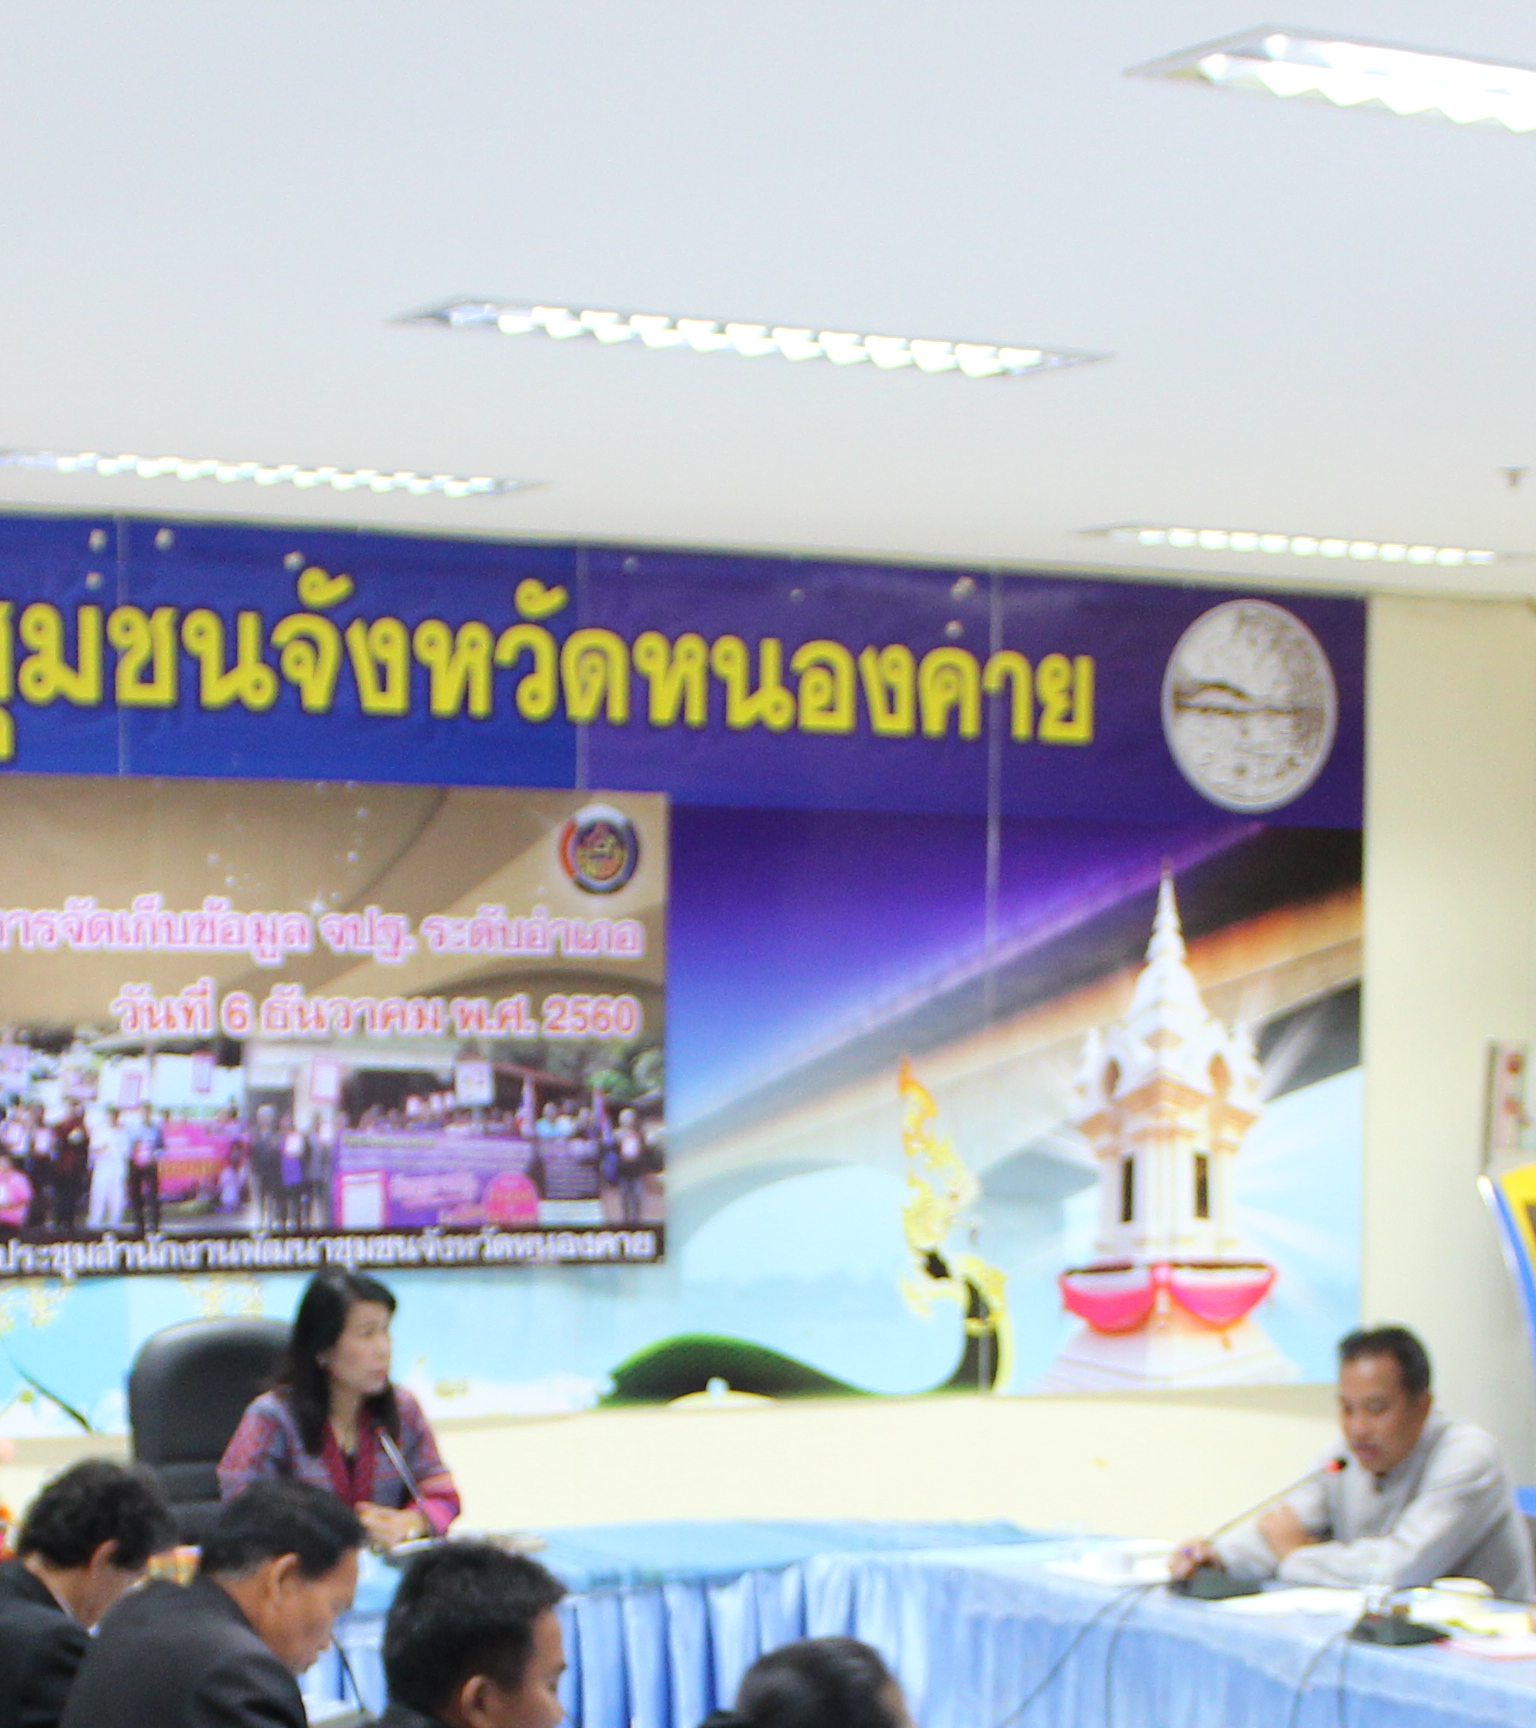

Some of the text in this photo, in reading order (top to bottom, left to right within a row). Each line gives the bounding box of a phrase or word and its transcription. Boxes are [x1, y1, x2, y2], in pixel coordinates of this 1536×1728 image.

[421, 903, 644, 959] ระดับอำเภอ
[110, 976, 641, 1040] วันที่ 6 ธันวาคม พ.ศ. 2560
